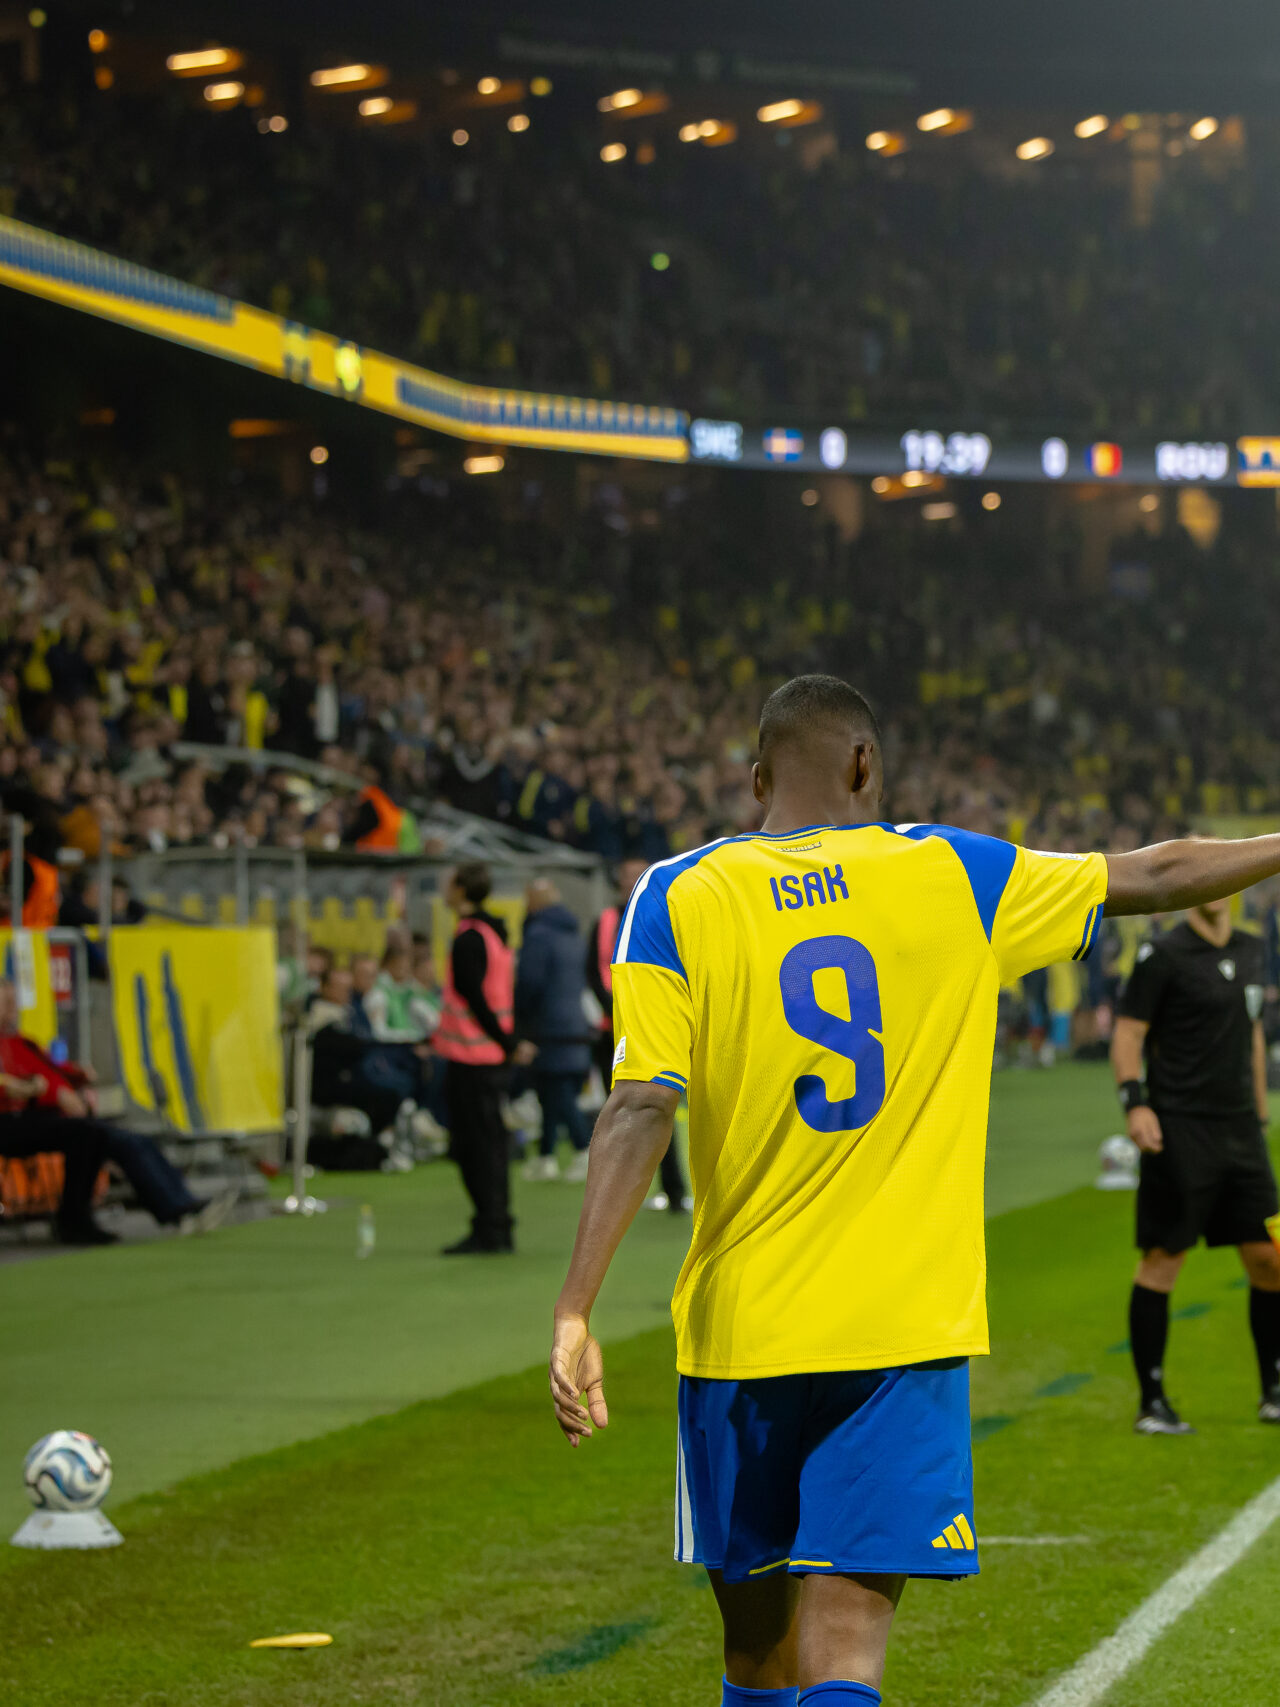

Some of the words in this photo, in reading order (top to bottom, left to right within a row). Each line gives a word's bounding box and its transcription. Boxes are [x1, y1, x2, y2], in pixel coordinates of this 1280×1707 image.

[819, 427, 847, 470] 0
[1042, 437, 1068, 479] 0
[1155, 442, 1228, 480] ROU
[769, 864, 850, 911] ISAK
[779, 935, 886, 1133] 9
